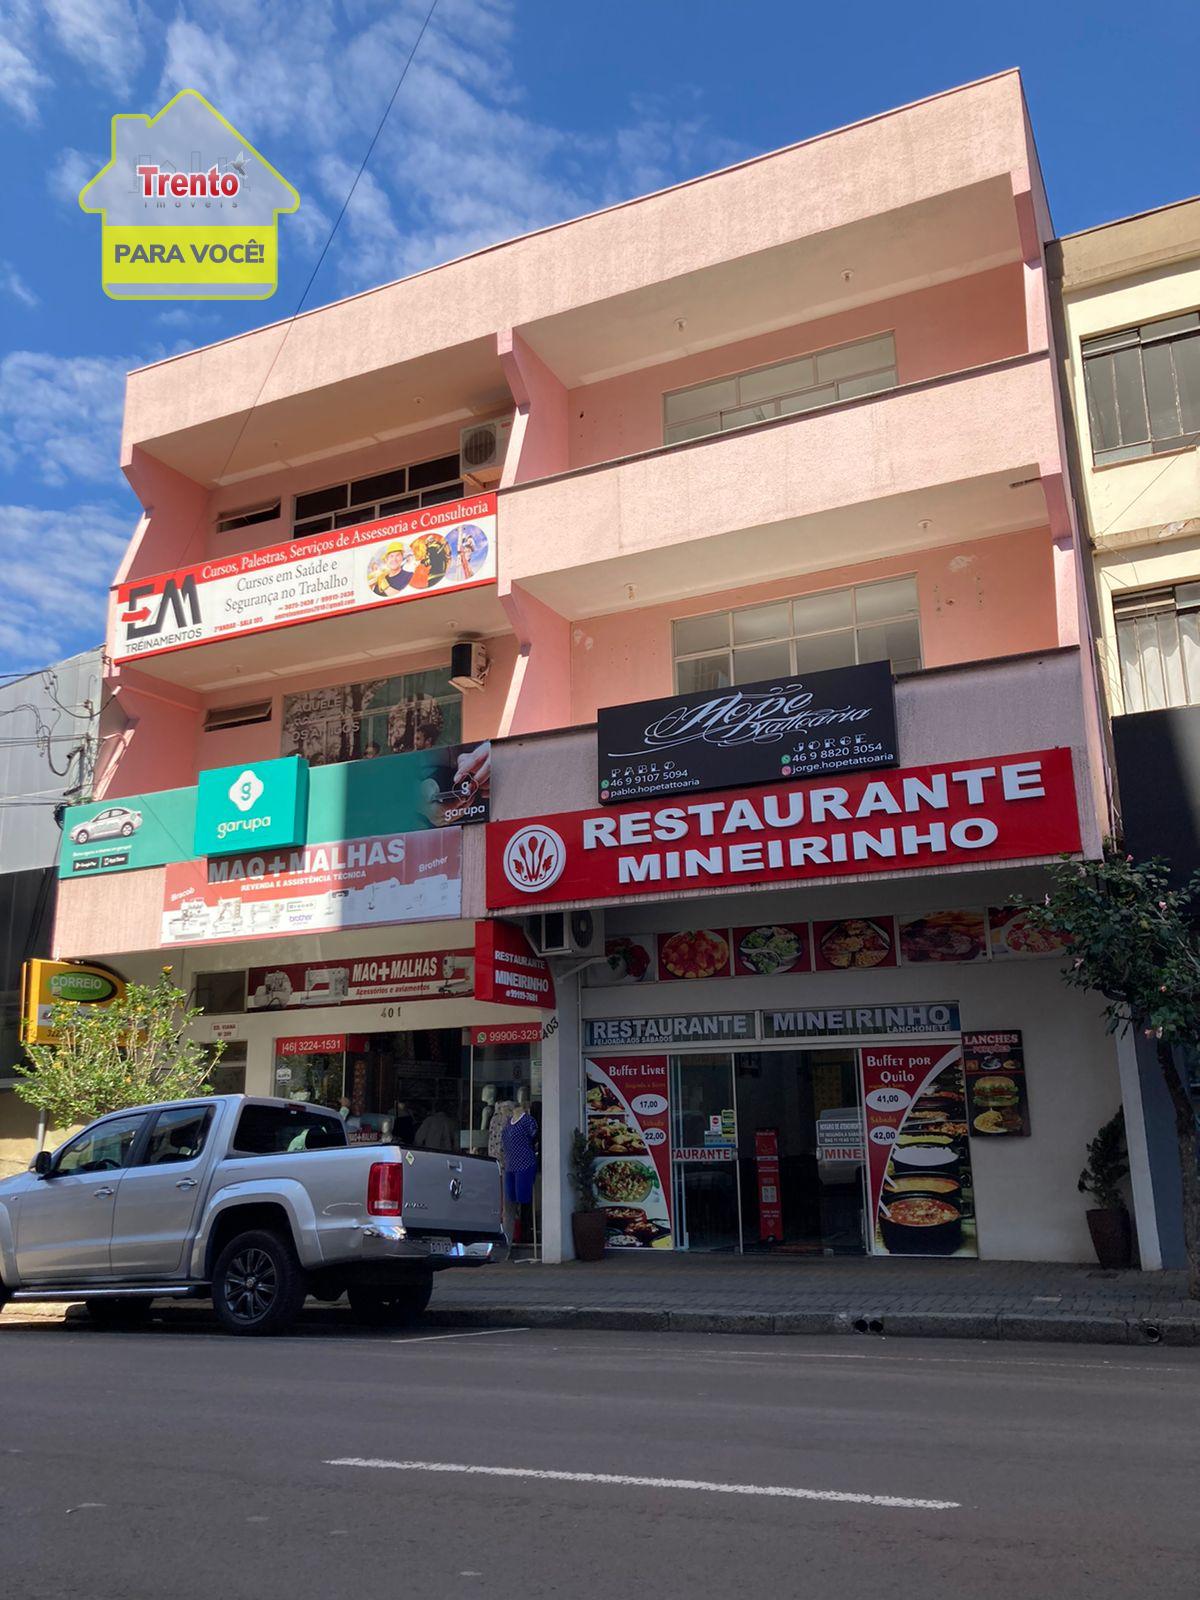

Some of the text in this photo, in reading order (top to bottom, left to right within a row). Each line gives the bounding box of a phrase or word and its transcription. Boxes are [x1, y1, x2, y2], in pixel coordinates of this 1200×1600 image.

[202, 500, 488, 579] Cursos, Palestras, Serviços de Assessoria e Consultoria
[237, 558, 338, 592] Cursos em Saúde e
[225, 574, 348, 613] Segurança no Trabalho
[125, 627, 202, 653] TREINAMENTOS
[793, 732, 867, 753] JORGE
[792, 742, 882, 763] 46 9 8820 3054
[611, 760, 676, 778] PABLO
[791, 752, 894, 775] jorge.hopetattoaria
[610, 769, 689, 787] 46 9 9107 5094
[610, 777, 700, 798] pablo.hopetattoaria
[444, 804, 485, 822] garupa
[583, 761, 1046, 850] RESTAURANTE
[217, 816, 271, 839] garupa
[618, 817, 999, 884] MINEIRINHO
[418, 855, 449, 873] Brother
[241, 881, 275, 892] REVENDA
[275, 880, 281, 888] E
[494, 950, 546, 970] RESTAURANTE
[50, 976, 102, 990] CORREIO
[356, 985, 389, 996] Acessórios
[394, 982, 431, 993] aviamentos
[495, 969, 549, 992] MINEIRINHO
[593, 1005, 950, 1039] RESTAURANTE MINEIRINHO
[887, 1024, 950, 1033] LANCHONETE
[299, 1039, 341, 1051] 3224-1531
[964, 1033, 1019, 1045] LANCHES
[880, 1071, 915, 1083] Quilo
[877, 1094, 899, 1104] 41,00
[645, 1132, 664, 1141] 22,00
[873, 1131, 896, 1141] 42,00
